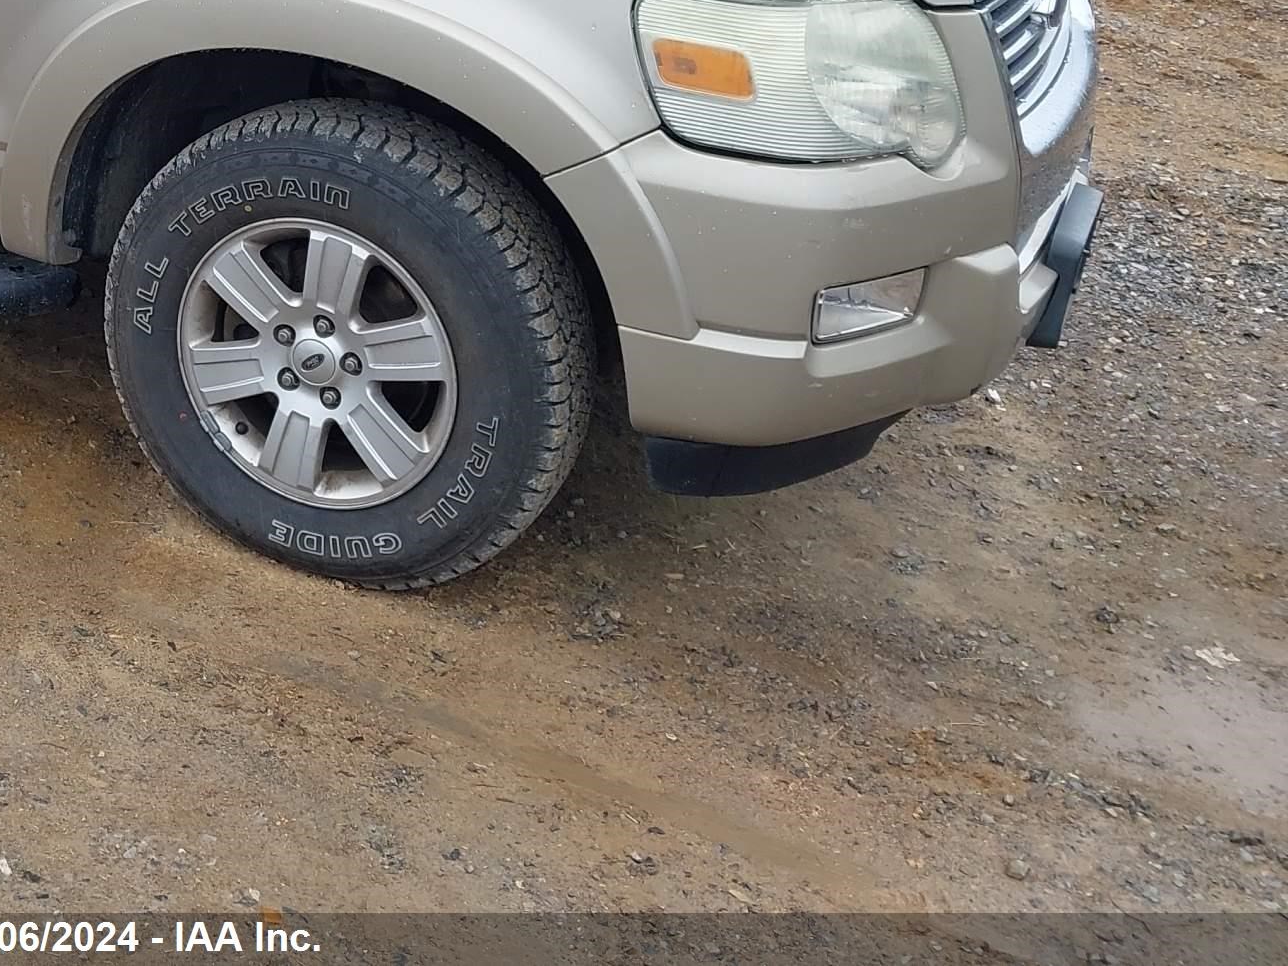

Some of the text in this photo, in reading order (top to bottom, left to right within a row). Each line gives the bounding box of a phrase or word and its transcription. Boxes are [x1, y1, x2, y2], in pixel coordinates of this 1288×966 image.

[133, 177, 350, 334] ALL TERRAIN
[268, 417, 499, 559] TRAIL GUIDE
